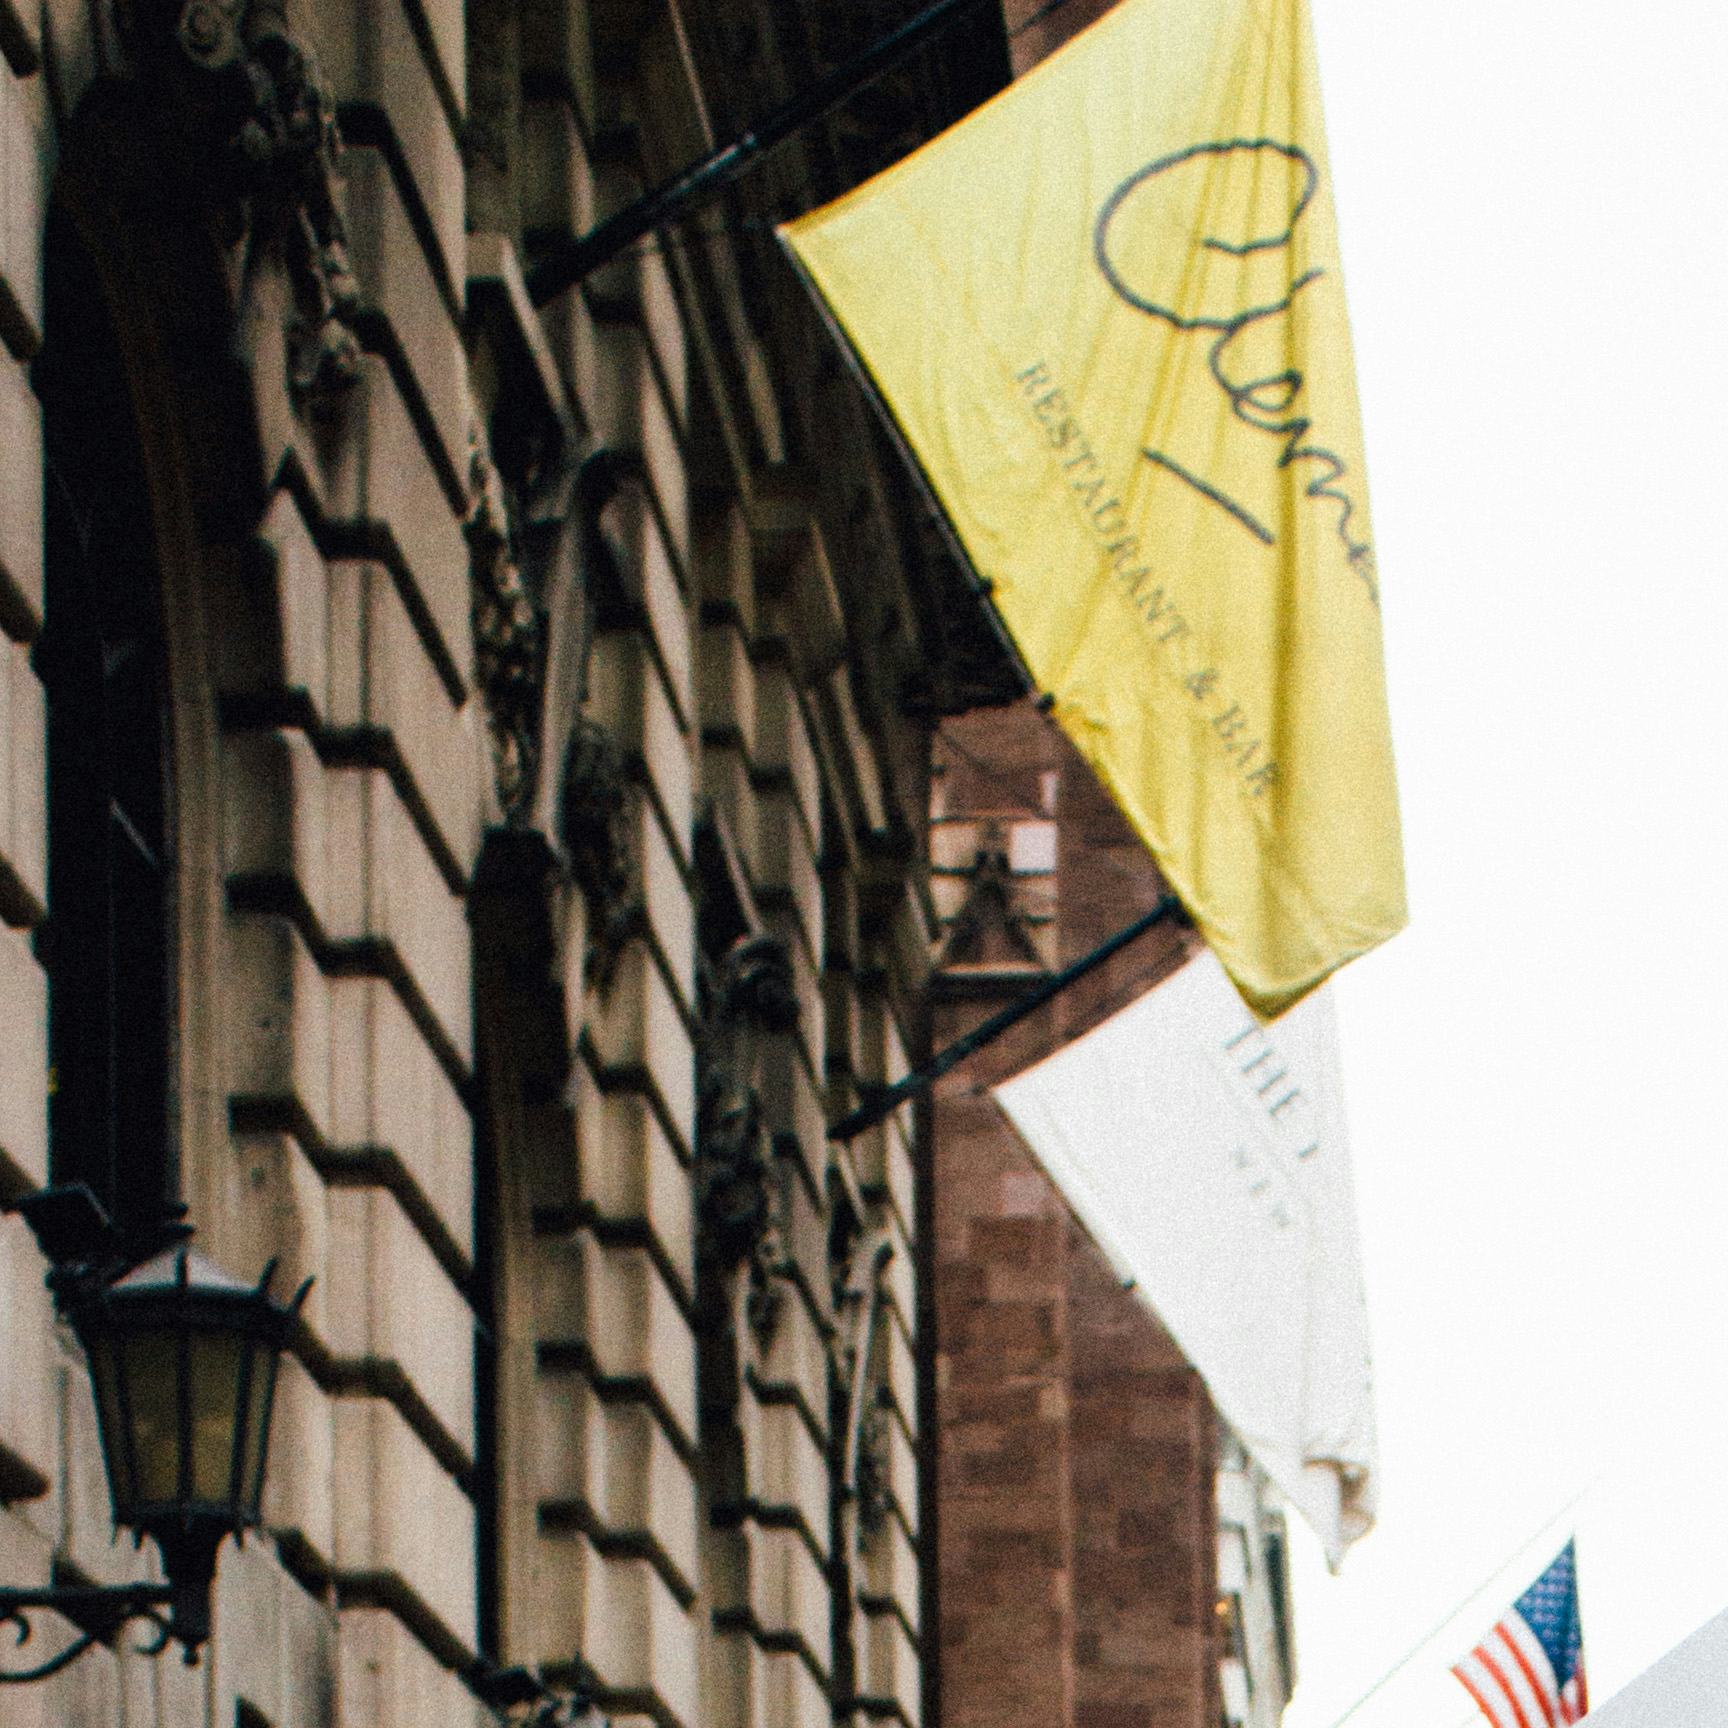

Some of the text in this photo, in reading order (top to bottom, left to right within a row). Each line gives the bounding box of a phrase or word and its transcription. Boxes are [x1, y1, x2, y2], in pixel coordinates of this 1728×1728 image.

[1014, 358, 1281, 797] RESTAURANT & BAR
